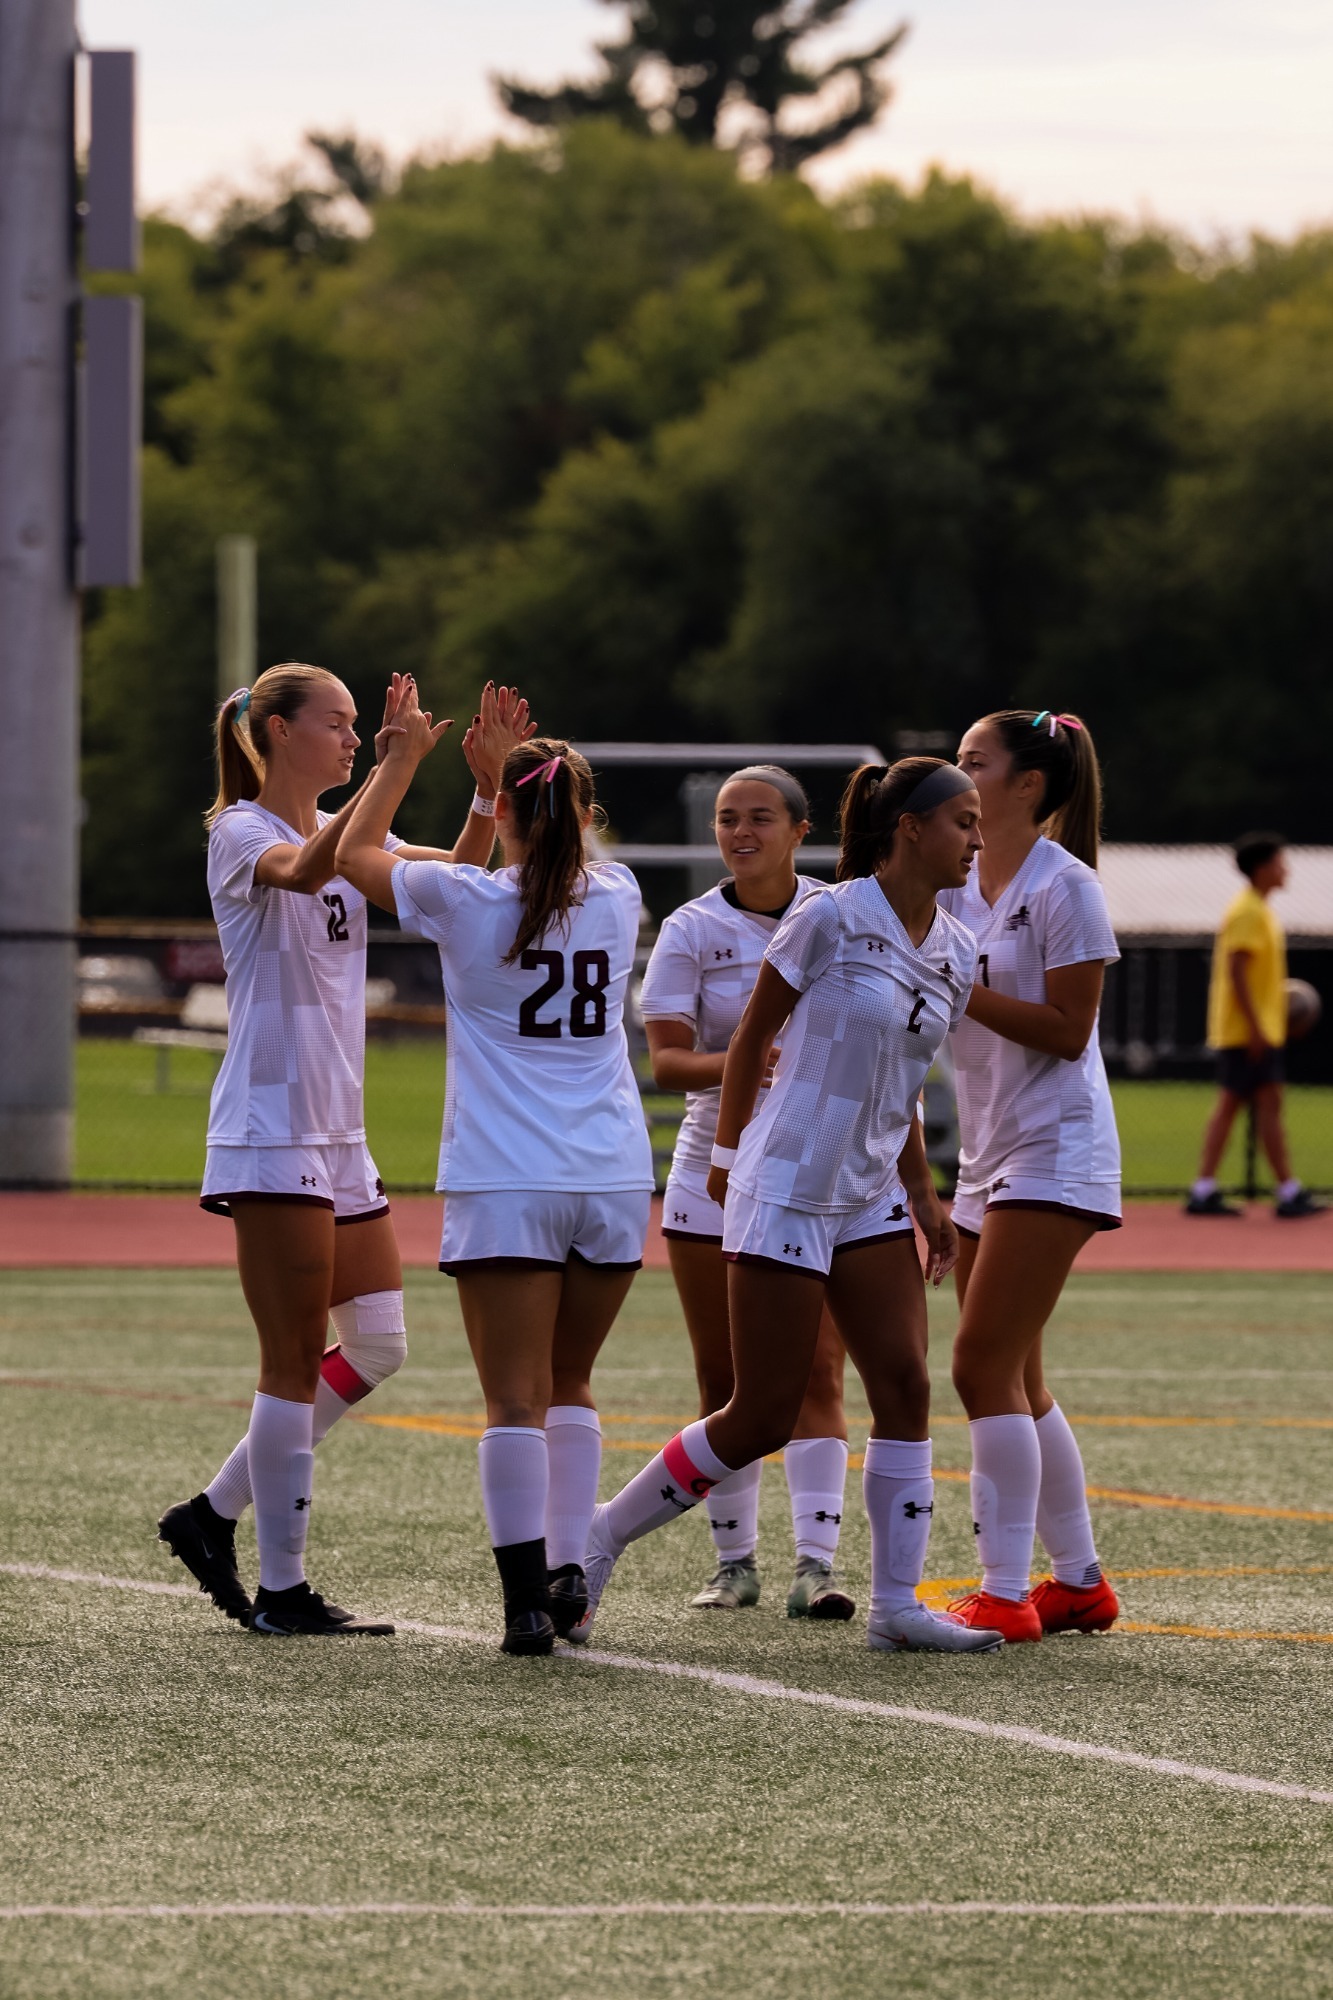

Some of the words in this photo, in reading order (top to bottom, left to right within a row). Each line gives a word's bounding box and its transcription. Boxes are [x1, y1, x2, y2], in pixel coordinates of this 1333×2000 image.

[323, 894, 349, 942] 12
[519, 949, 610, 1038] 28
[907, 988, 927, 1035] 2
